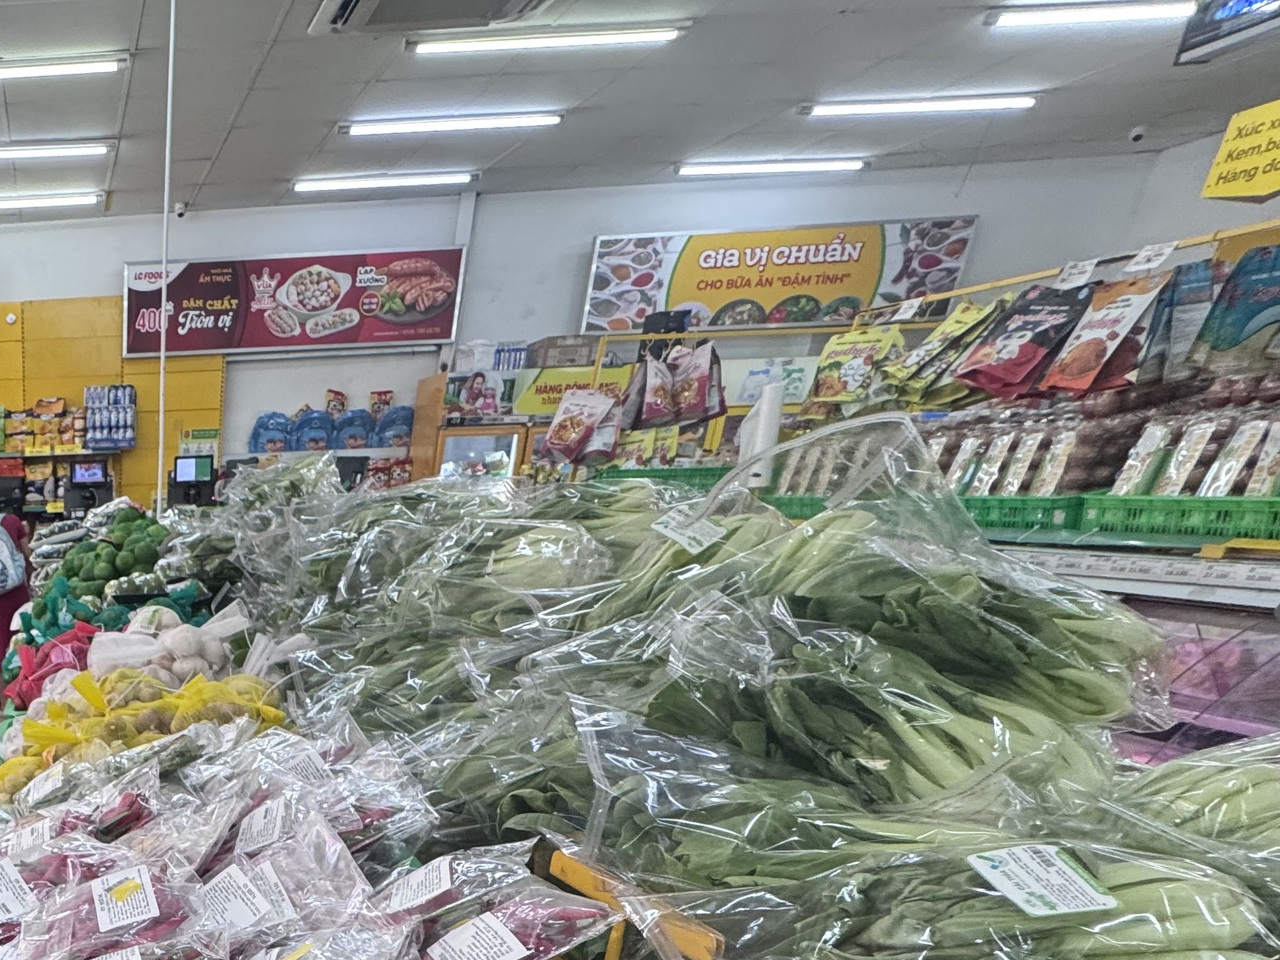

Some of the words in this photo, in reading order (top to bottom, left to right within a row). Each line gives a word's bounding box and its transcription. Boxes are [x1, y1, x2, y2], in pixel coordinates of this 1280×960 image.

[696, 279, 723, 291] CHO
[726, 275, 752, 289] BỮA
[754, 274, 773, 288] ĂN
[206, 295, 238, 310] CHẤT
[178, 310, 215, 335] Tròn
[218, 312, 234, 332] vị
